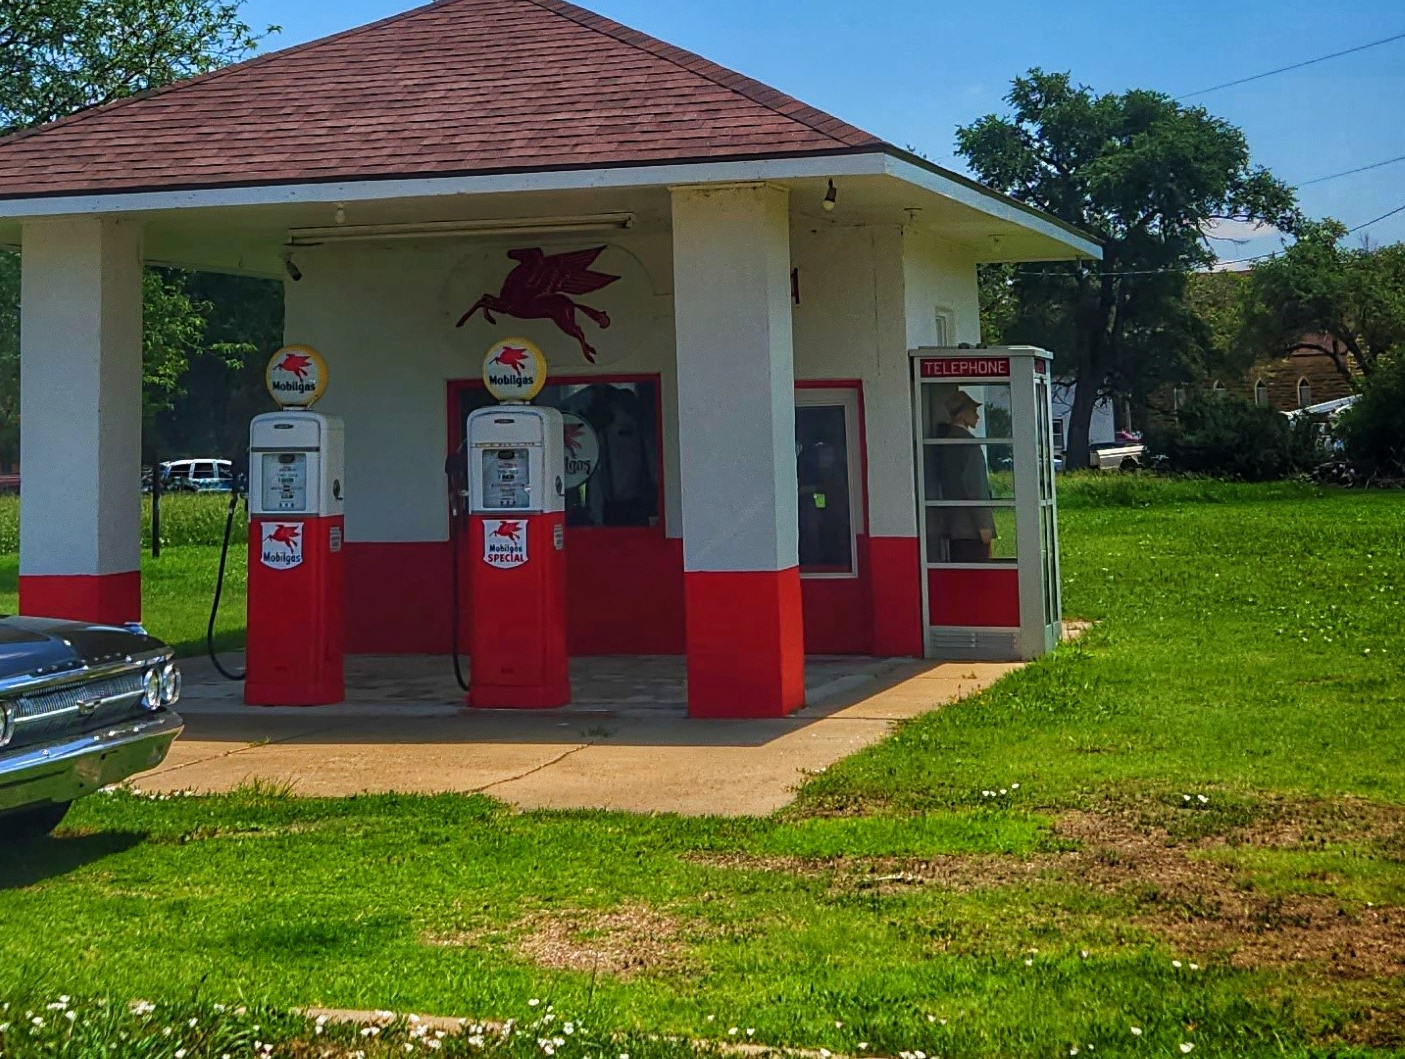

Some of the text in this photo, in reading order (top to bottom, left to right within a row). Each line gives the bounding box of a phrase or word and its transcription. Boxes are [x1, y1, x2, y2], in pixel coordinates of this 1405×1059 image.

[924, 360, 1007, 375] TELEPHONE
[272, 381, 316, 394] Mobilgas
[488, 375, 534, 388] Mobilgas
[489, 543, 523, 553] Mobilgas
[263, 551, 301, 565] Mobilgas
[487, 553, 525, 562] SPECIAL
